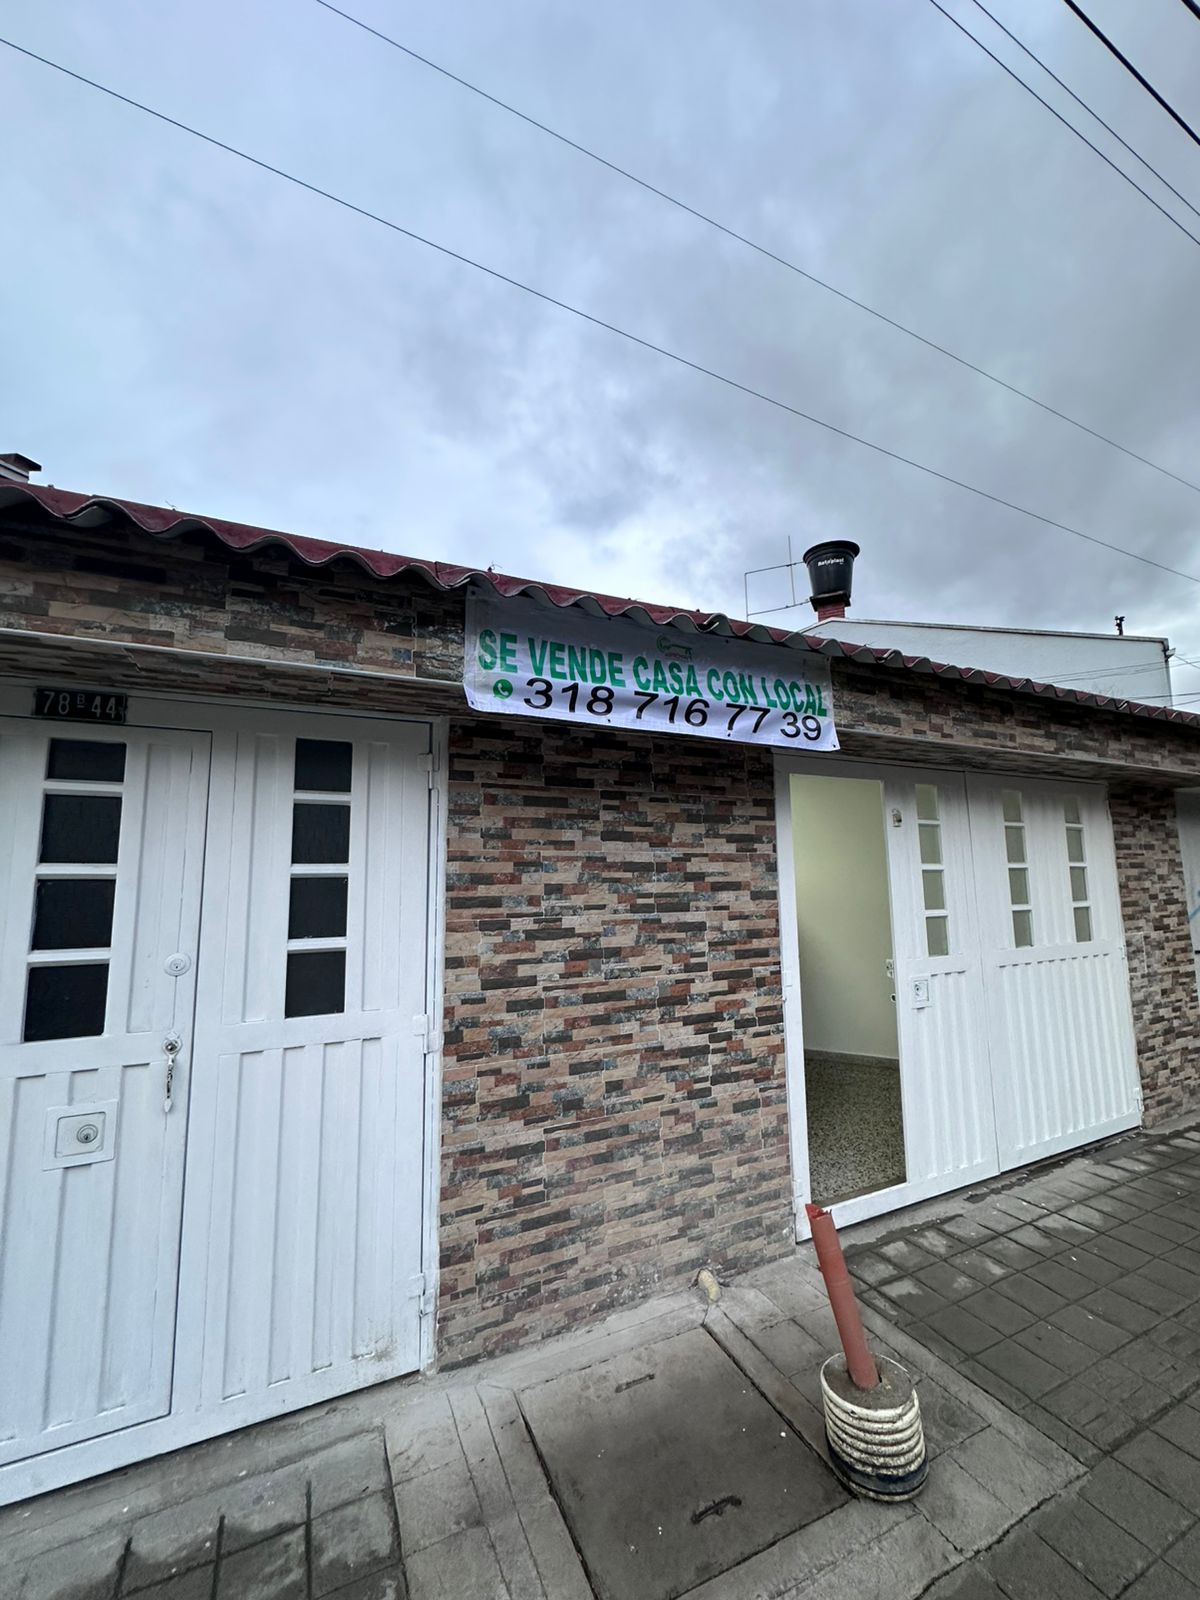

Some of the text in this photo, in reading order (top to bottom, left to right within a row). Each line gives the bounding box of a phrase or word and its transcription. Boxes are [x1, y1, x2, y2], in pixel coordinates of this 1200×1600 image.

[478, 629, 827, 717] SE VENDE CASA CON LOCAL
[92, 695, 116, 719] 44
[523, 677, 822, 741] 318 716 77 39
